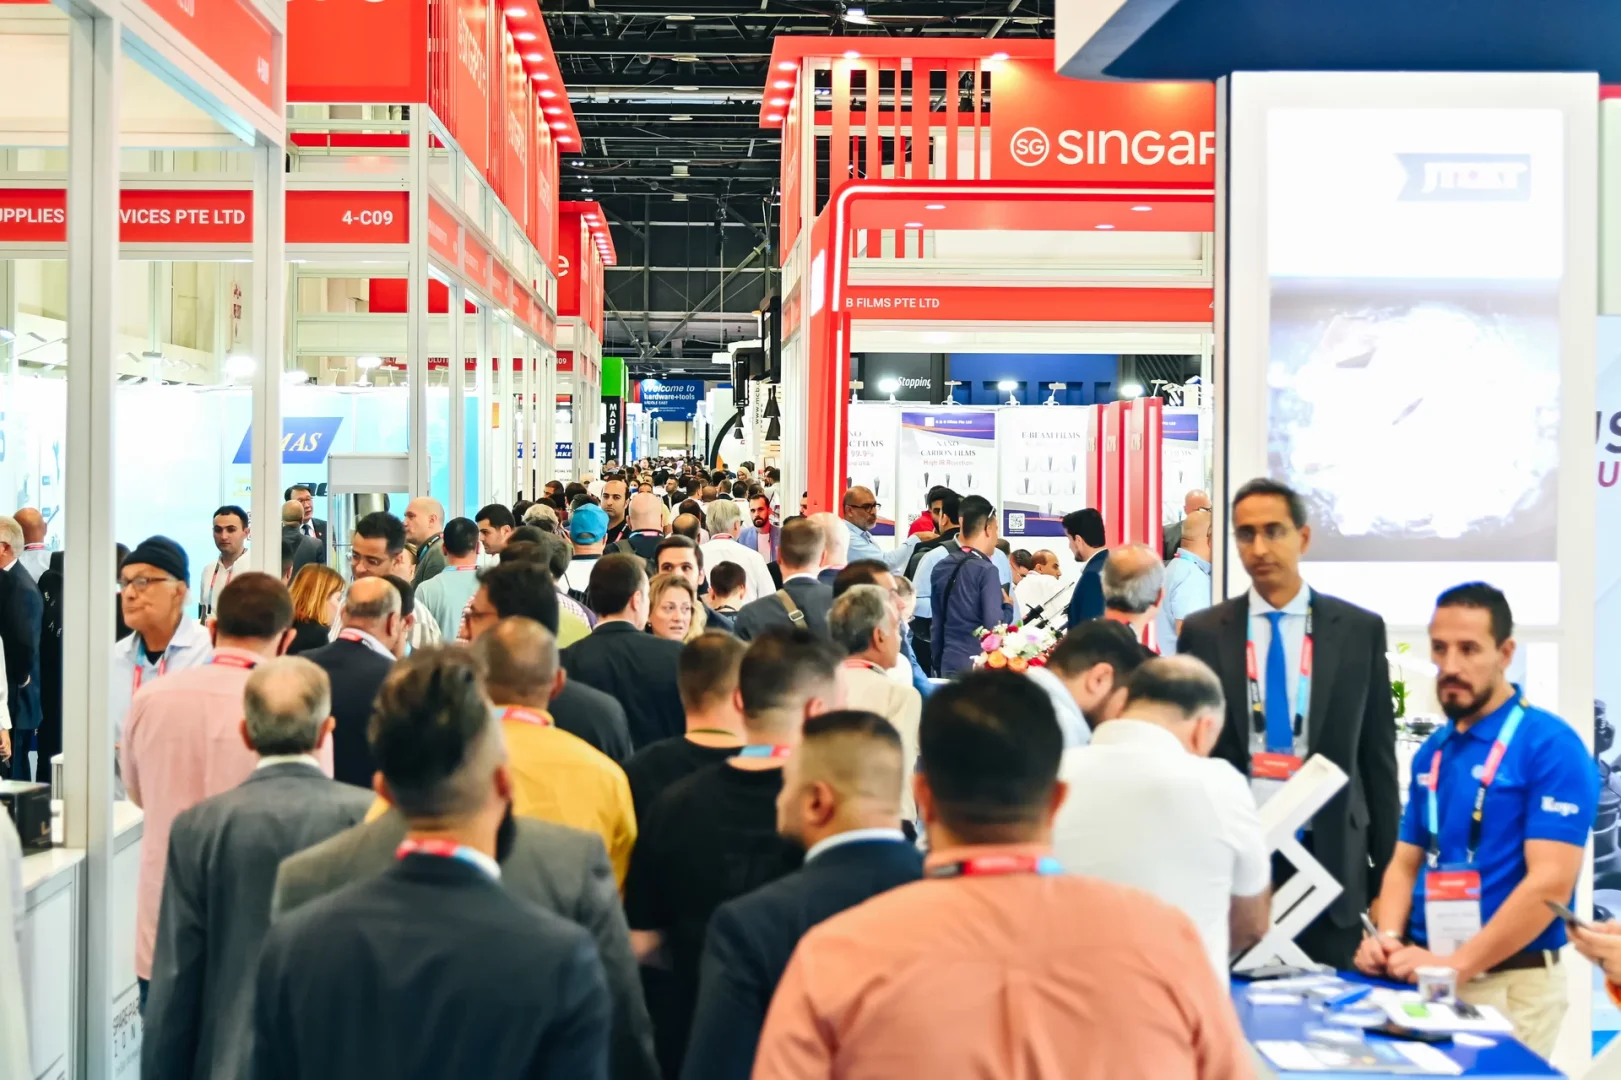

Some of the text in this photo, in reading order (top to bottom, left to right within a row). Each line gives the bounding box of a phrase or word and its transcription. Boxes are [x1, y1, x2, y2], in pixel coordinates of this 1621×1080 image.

[1015, 138, 1045, 156] SG
[0, 208, 394, 226] PPLIES VICES PTE LTD 4-C09
[856, 297, 892, 309] FILMS
[894, 297, 917, 309] PTE
[919, 297, 940, 309] LTD
[642, 384, 696, 393] Welcome to
[898, 376, 931, 389] Stopping
[643, 393, 696, 401] hardware+tools
[609, 403, 617, 456] MADE IN
[1055, 431, 1081, 439] FILMS
[920, 449, 977, 457] CARBON FILMS
